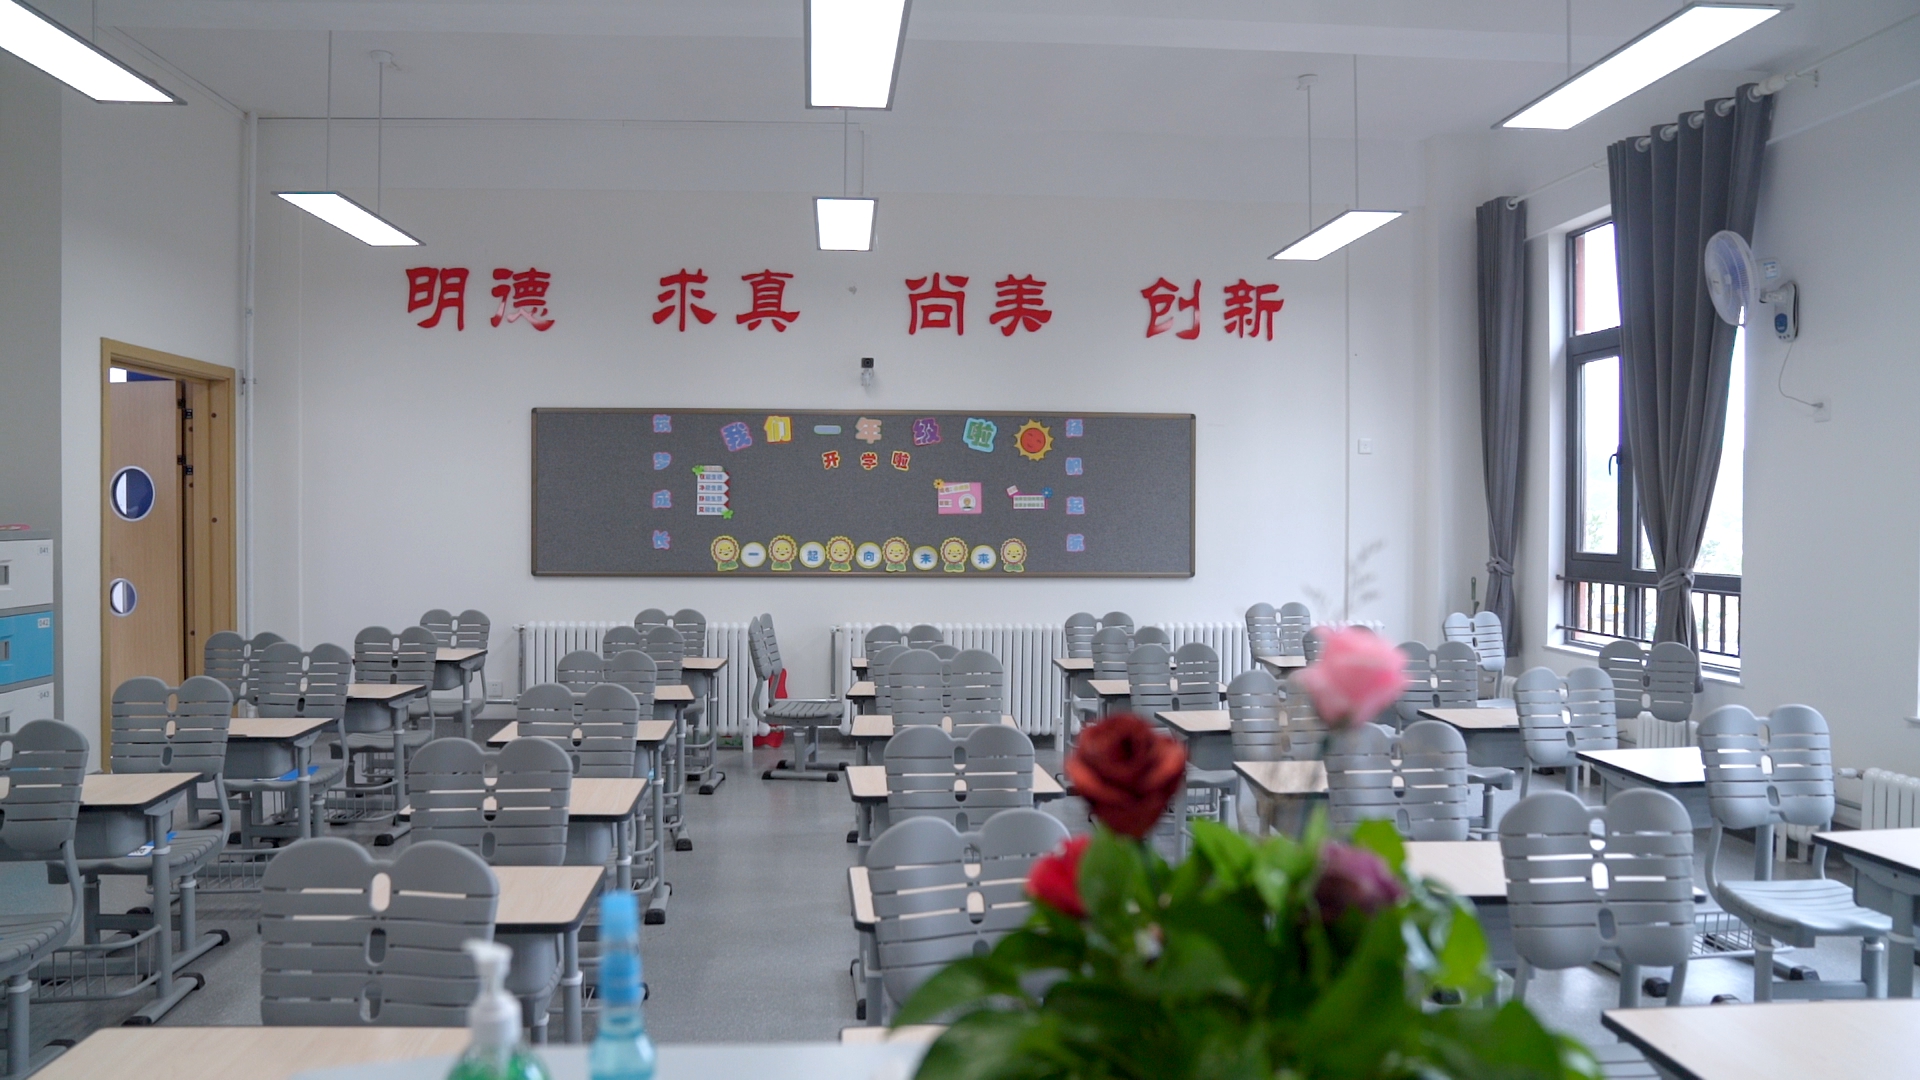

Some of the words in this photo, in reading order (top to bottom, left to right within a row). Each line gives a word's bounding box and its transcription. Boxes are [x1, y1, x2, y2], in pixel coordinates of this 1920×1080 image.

[406, 267, 555, 331] 明德
[652, 268, 800, 332] 求真
[905, 272, 1052, 336] 尚美
[1140, 277, 1284, 341] 创新
[720, 415, 998, 452] 我们一年级啦
[822, 450, 911, 471] 开学啦
[748, 550, 989, 565] 一起向未来
